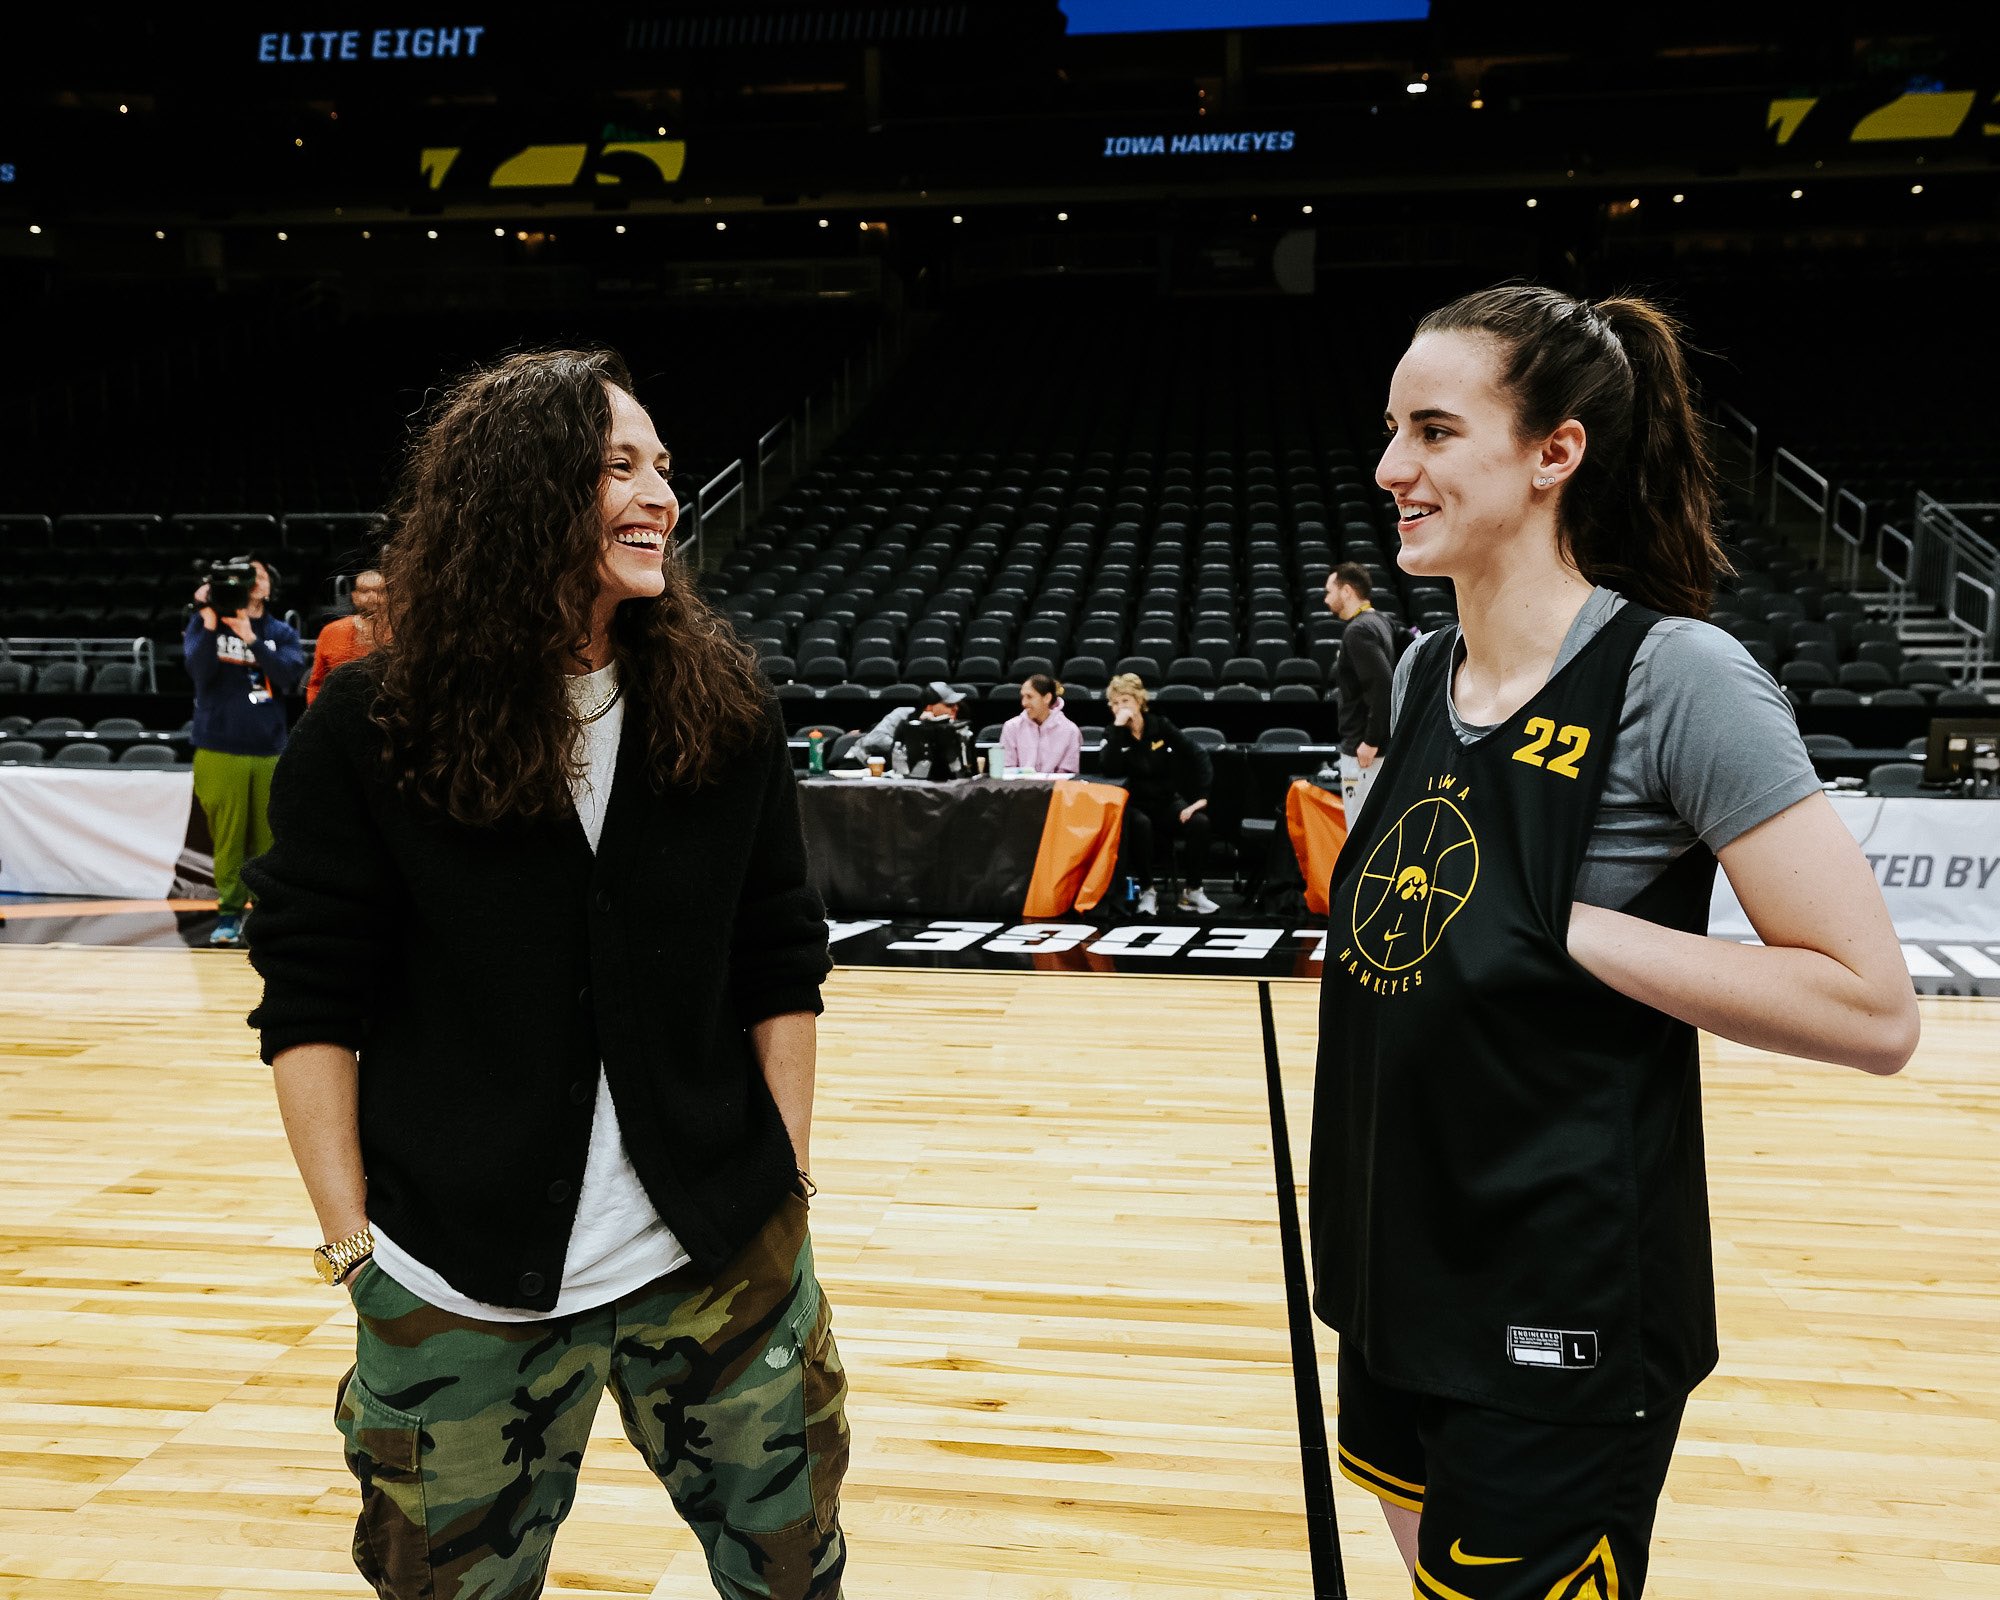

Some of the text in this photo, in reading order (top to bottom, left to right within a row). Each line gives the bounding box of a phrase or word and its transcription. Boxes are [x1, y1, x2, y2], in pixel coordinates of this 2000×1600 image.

[258, 26, 485, 62] ELITE EIGHT
[1104, 130, 1296, 157] IOWA HAWKEYES
[1512, 716, 1591, 780] 22
[1944, 855, 2000, 889] BY
[1339, 948, 1422, 995] HAWKEYES
[1574, 1342, 1586, 1360] L
